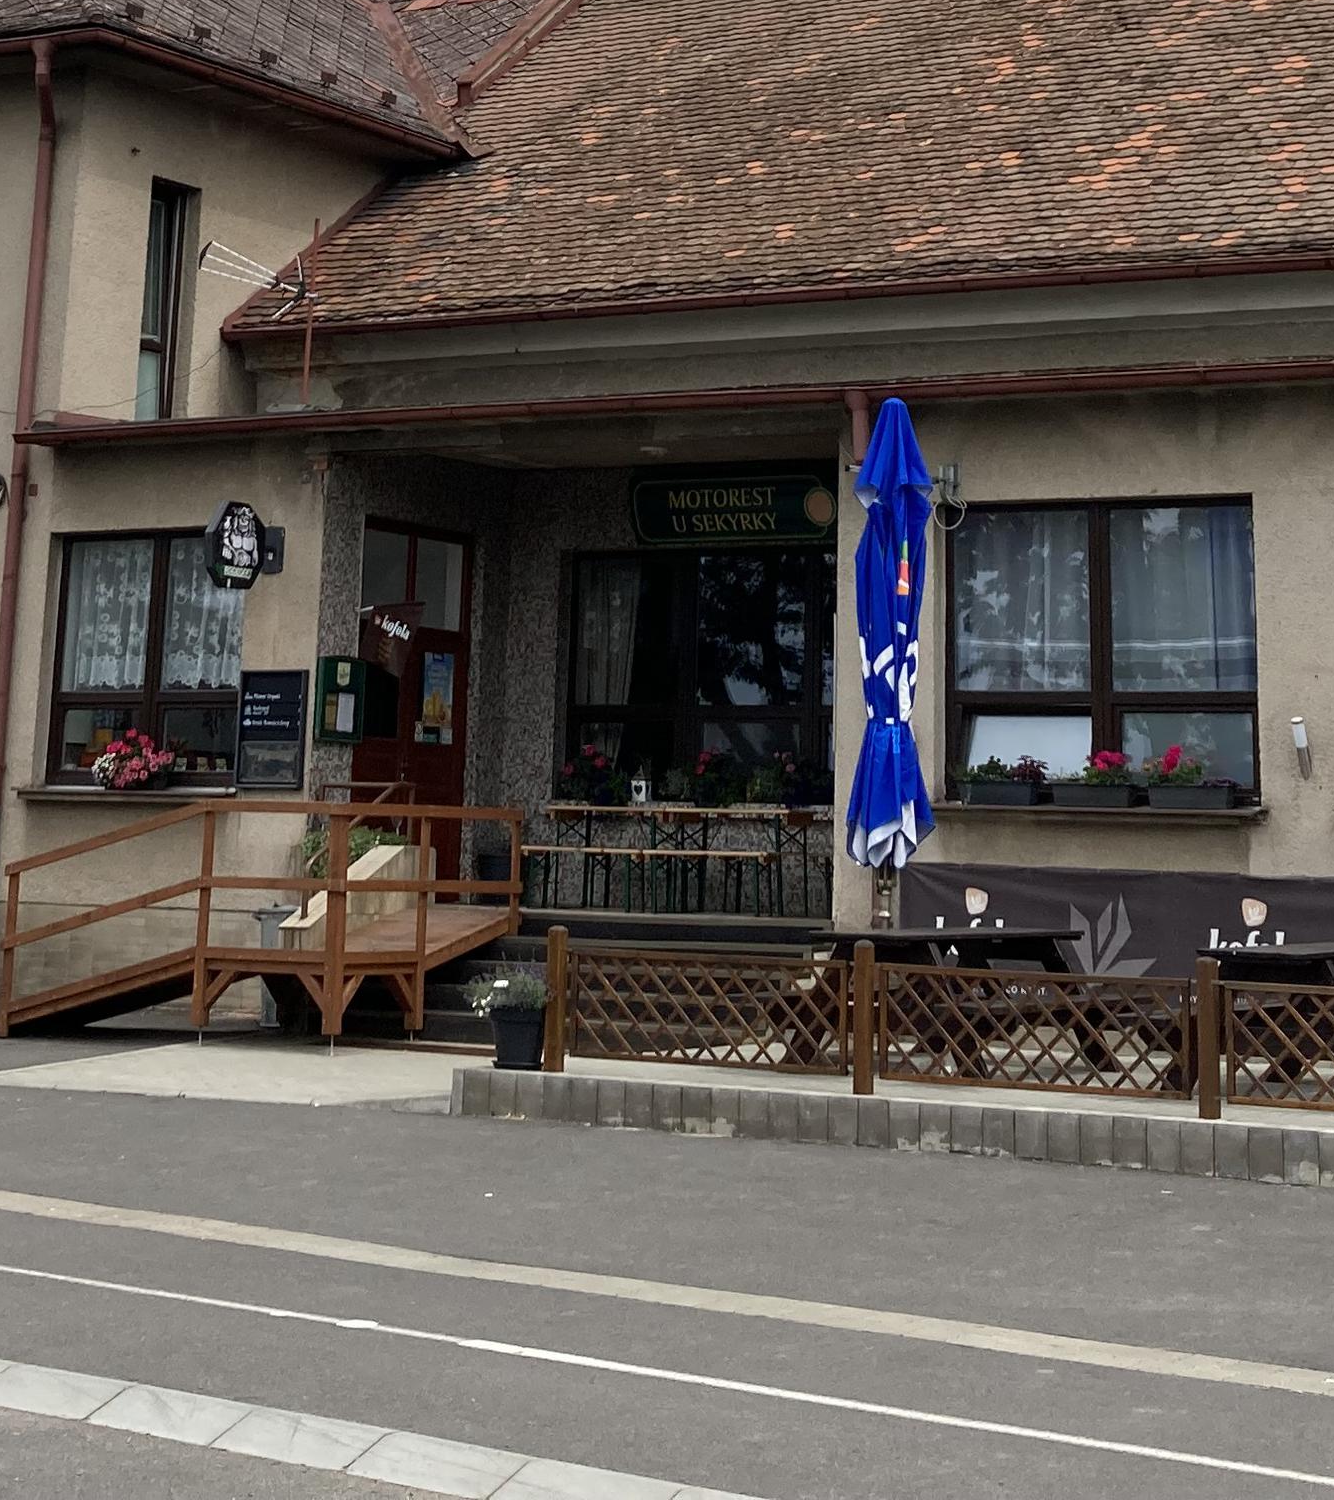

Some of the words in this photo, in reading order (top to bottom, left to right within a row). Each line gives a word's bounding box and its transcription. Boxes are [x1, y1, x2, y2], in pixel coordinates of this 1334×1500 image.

[668, 486, 776, 510] MOTOREST
[672, 514, 687, 532] U
[692, 512, 776, 532] SEKYRKY
[380, 613, 411, 641] kofola
